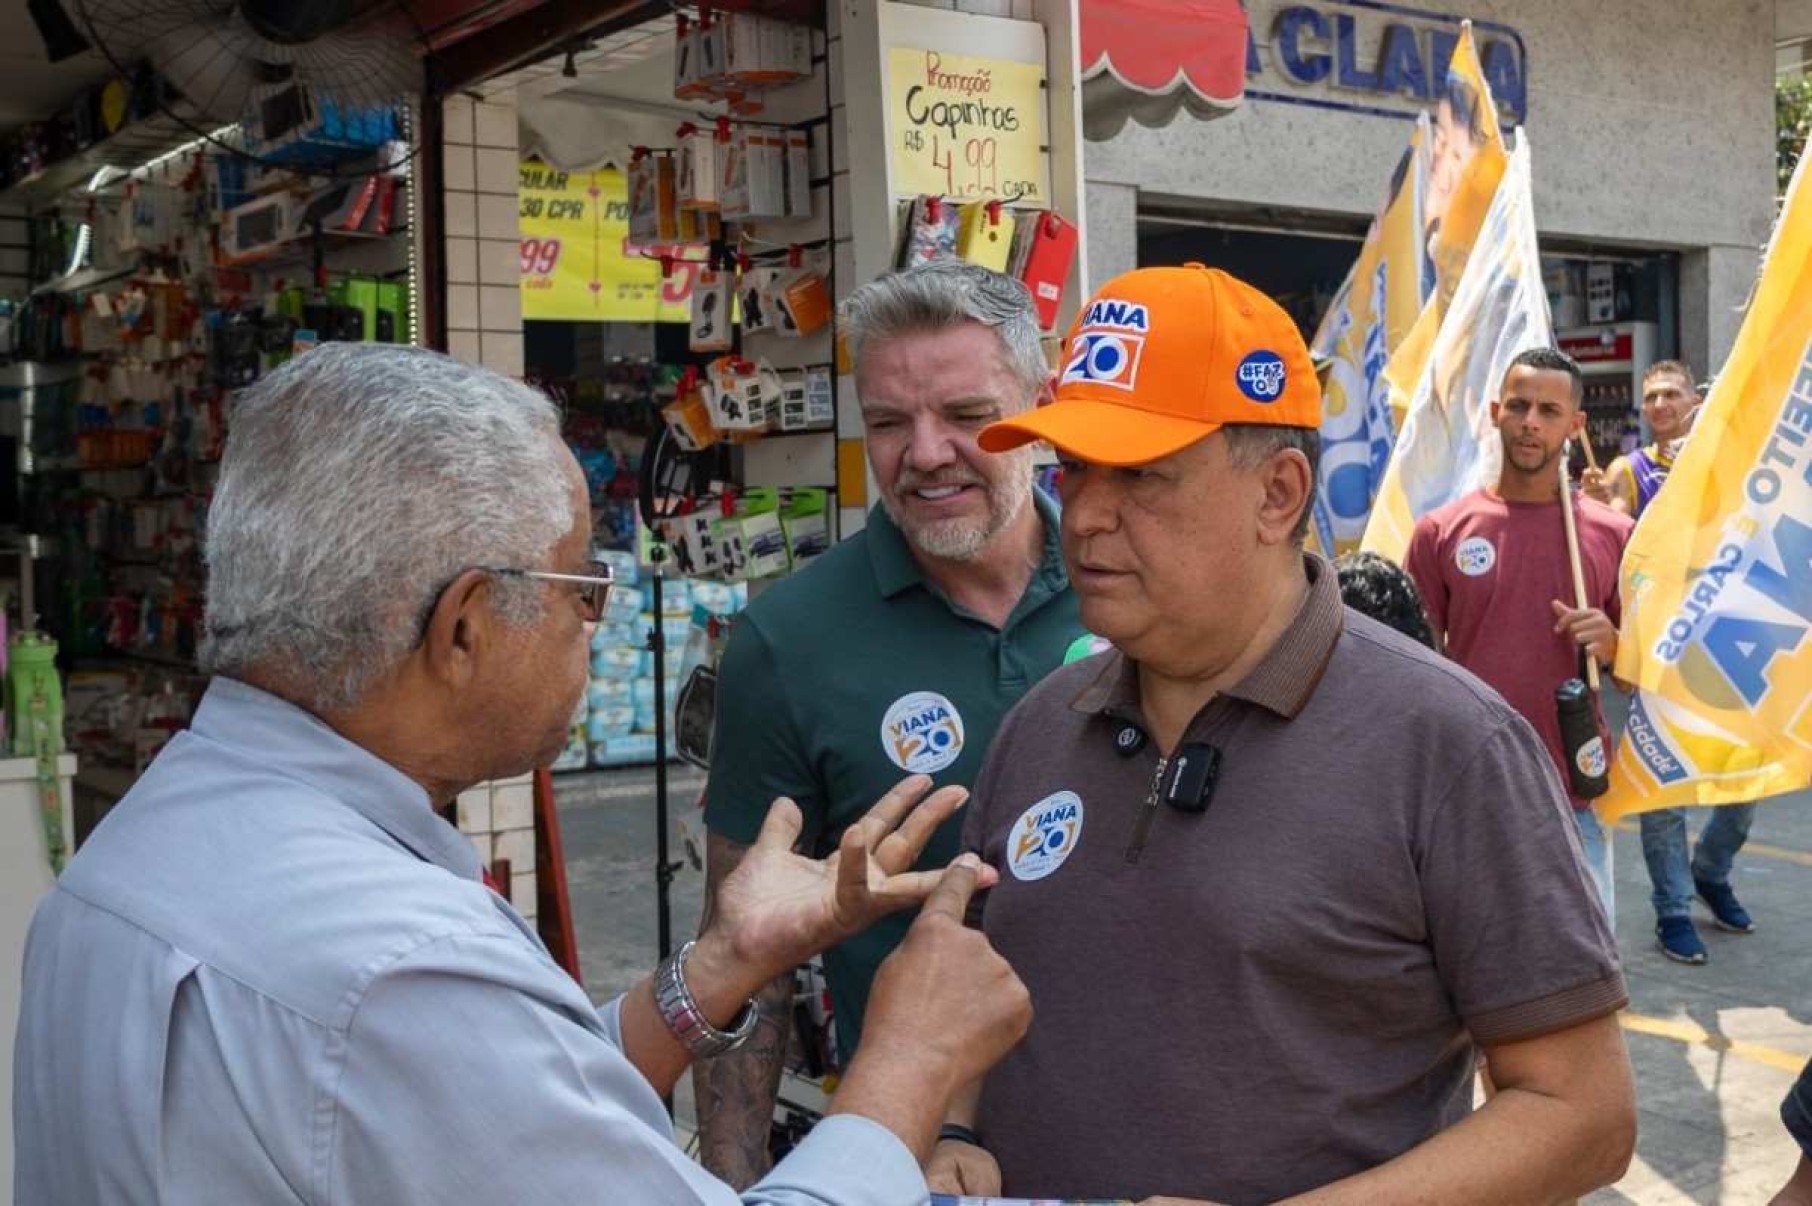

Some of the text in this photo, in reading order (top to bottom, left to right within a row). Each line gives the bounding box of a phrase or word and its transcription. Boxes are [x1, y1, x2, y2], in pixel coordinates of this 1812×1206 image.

[906, 85, 1020, 140] Capinhas
[547, 199, 584, 219] CPR
[1081, 301, 1147, 331] IANA
[889, 707, 950, 735] VIANA
[1026, 805, 1077, 829] VIANA
